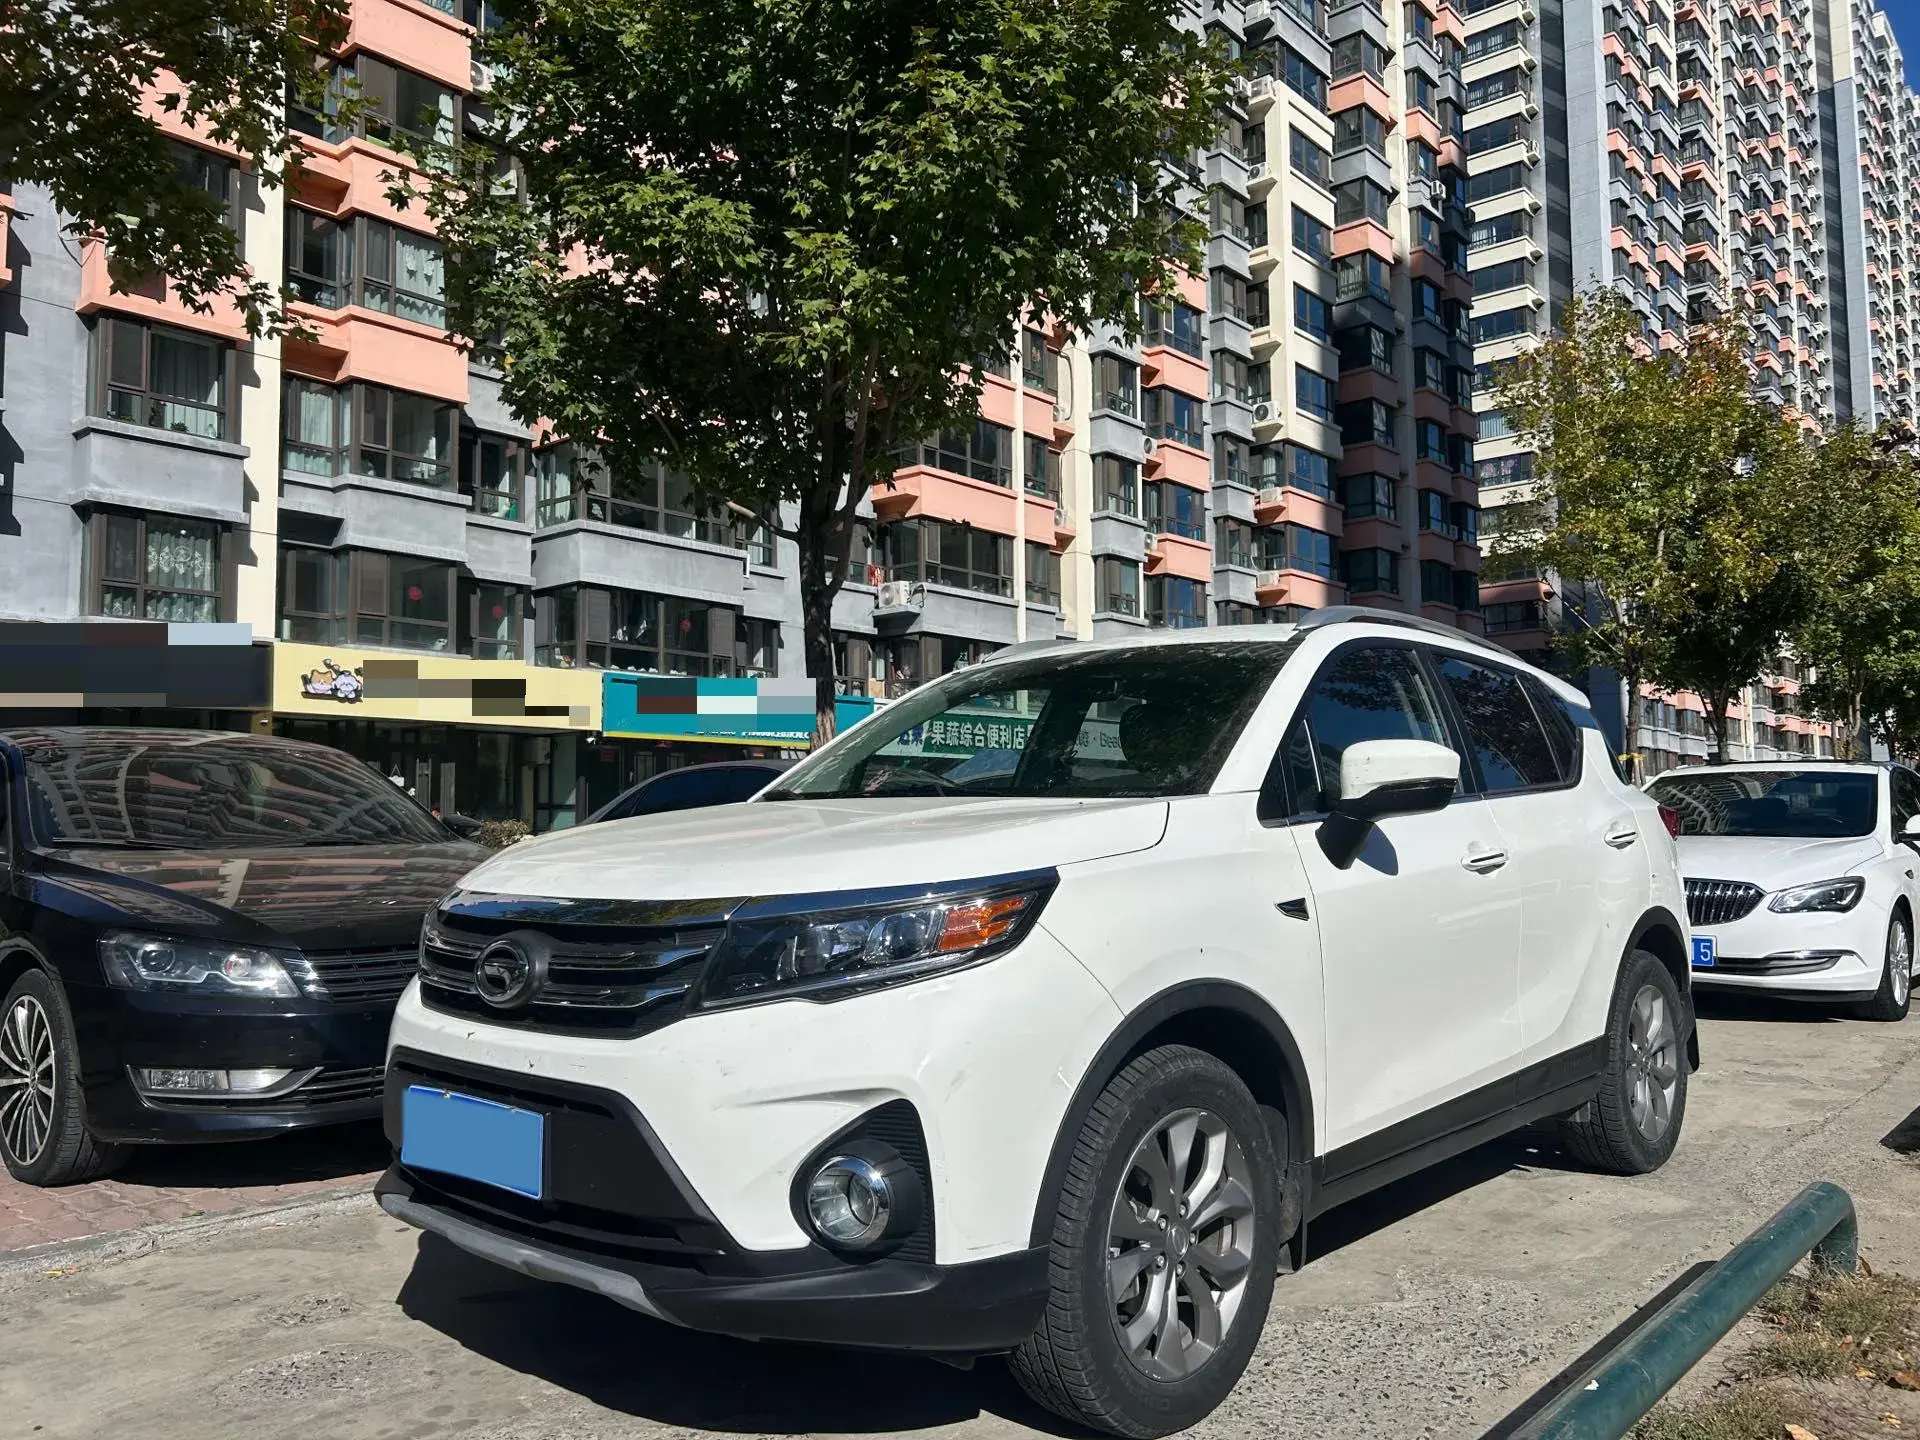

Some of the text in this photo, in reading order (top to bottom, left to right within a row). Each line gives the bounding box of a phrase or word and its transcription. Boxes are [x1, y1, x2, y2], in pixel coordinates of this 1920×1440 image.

[931, 720, 1025, 749] 果蔬综合便利店
